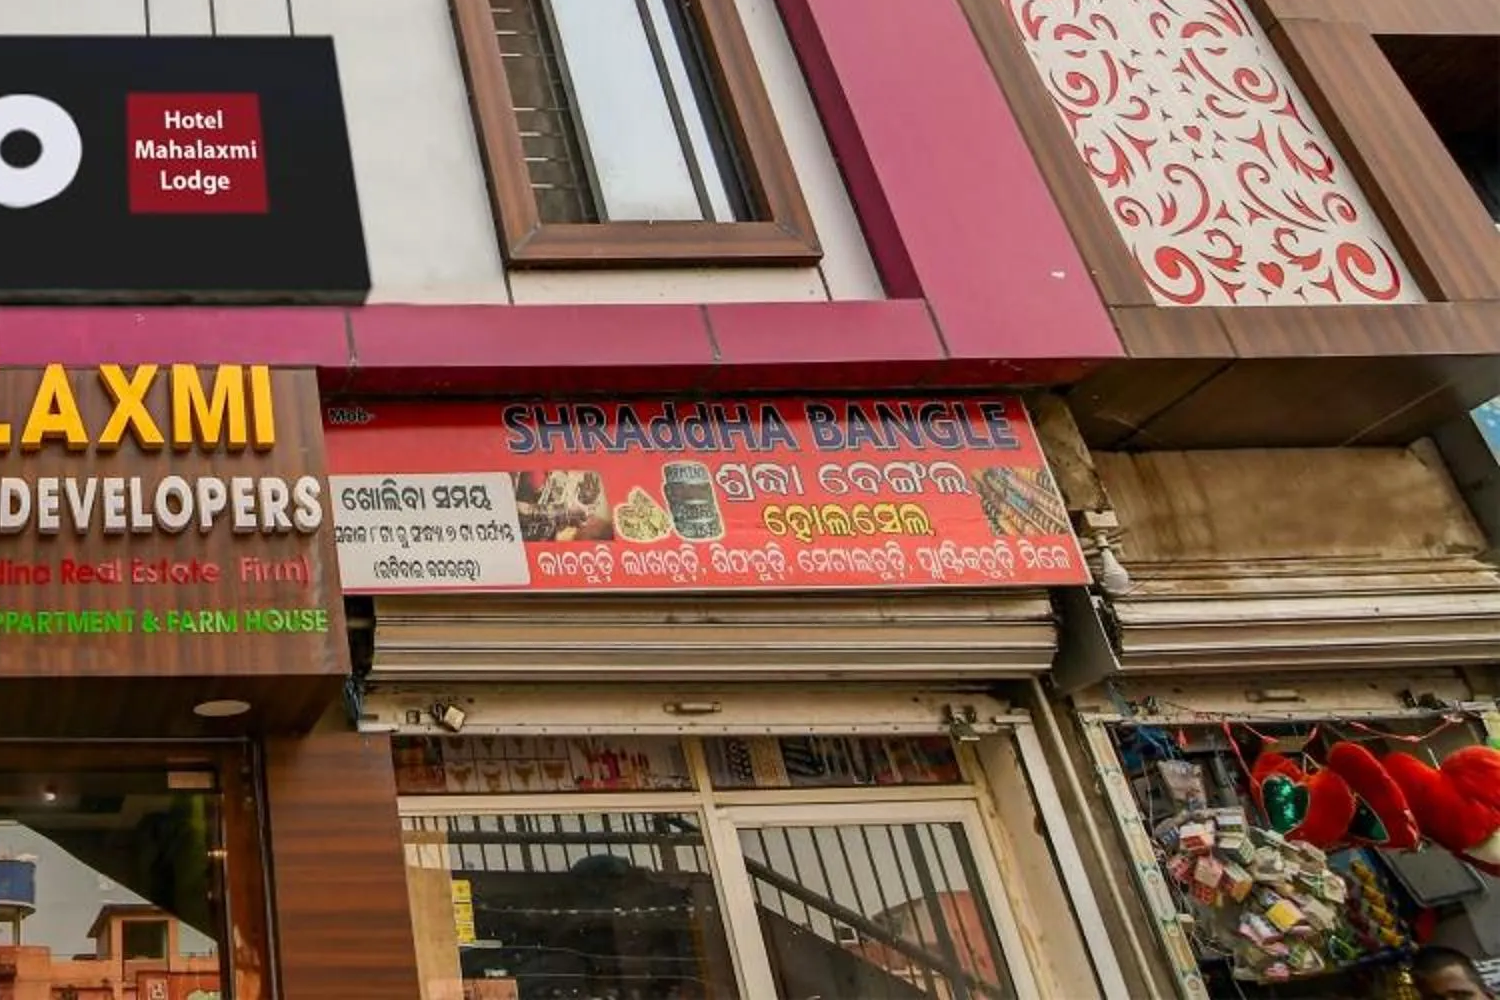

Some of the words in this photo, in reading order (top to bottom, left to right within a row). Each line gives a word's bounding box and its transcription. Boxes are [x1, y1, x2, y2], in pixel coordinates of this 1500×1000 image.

[164, 110, 223, 129] Hotel
[135, 139, 257, 159] Mahalaxmi
[160, 169, 230, 195] Lodge
[503, 402, 798, 452] SHRAddHA
[806, 402, 1020, 451] BANGLE
[0, 475, 324, 534] DEVELOPERS
[61, 556, 121, 587] Real
[132, 557, 221, 587] Estate
[241, 555, 311, 589] Firm)
[142, 609, 161, 634] &
[168, 608, 238, 634] FARM
[245, 607, 329, 634] HOUSE
